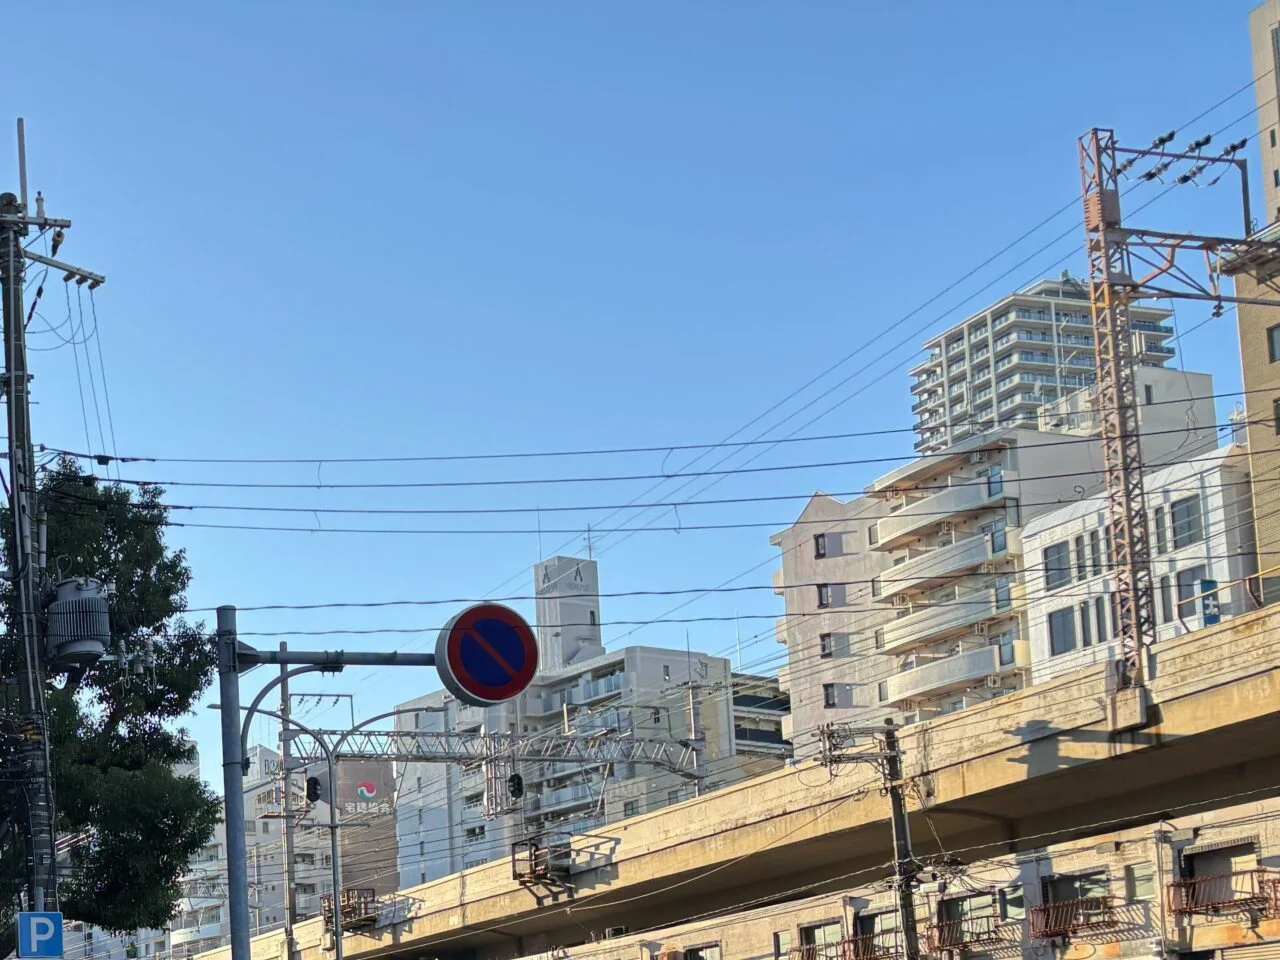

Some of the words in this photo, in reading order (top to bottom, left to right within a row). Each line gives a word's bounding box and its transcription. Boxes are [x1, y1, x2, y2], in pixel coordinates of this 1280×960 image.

[345, 802, 392, 814] 宅建協会
[30, 917, 55, 952] P
